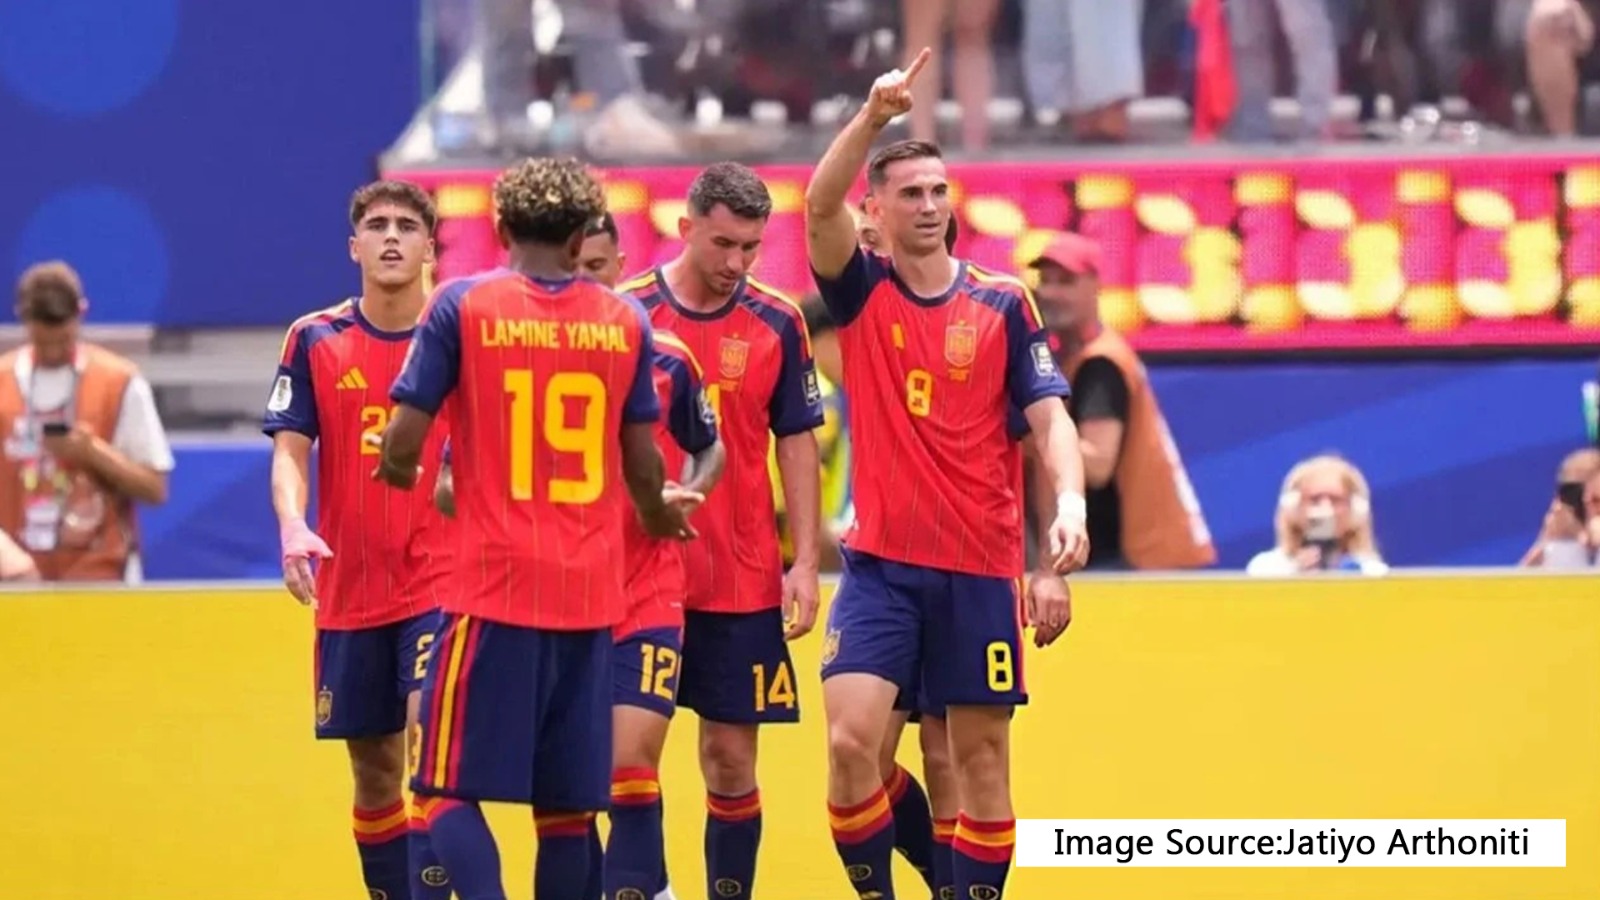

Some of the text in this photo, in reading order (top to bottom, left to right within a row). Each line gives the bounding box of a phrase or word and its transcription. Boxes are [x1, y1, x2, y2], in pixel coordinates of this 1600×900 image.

[480, 318, 630, 352] LAMINE YAMAL
[907, 369, 932, 417] 8
[360, 406, 398, 455] 2
[503, 369, 607, 505] 19
[639, 643, 677, 701] 12
[753, 660, 796, 712] 14
[987, 641, 1014, 692] 8
